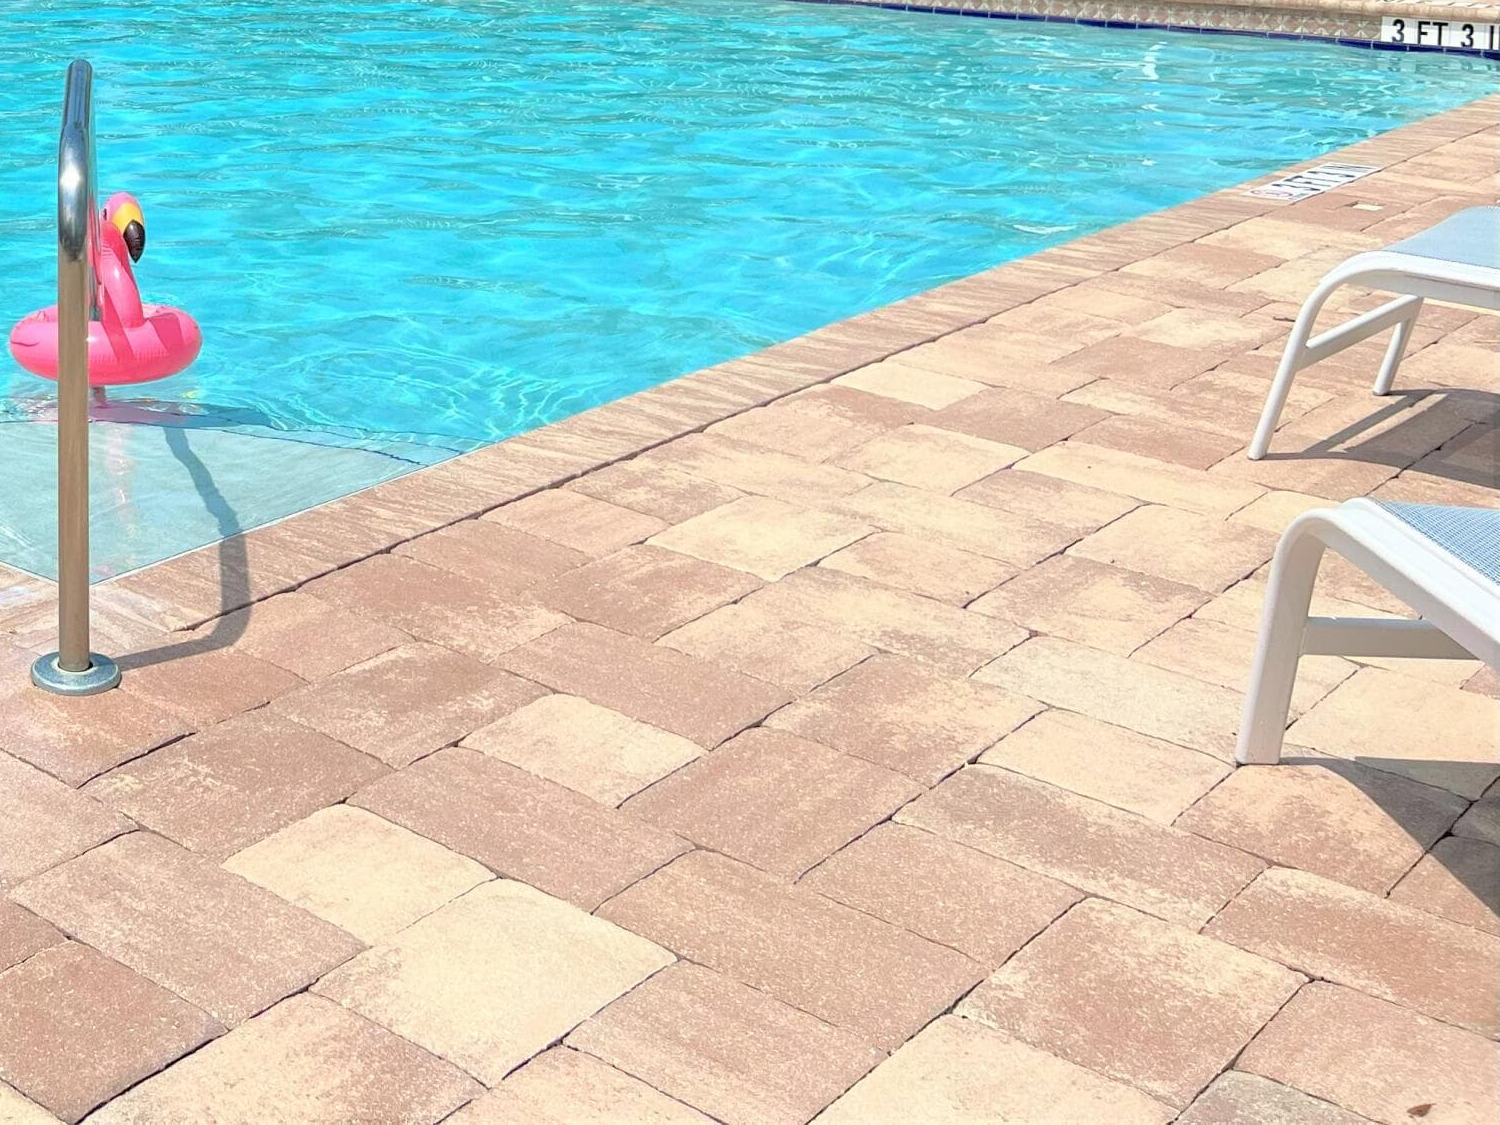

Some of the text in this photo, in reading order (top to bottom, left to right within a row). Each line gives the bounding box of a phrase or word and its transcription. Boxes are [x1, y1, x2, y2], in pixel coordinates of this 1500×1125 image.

[1392, 19, 1500, 50] 3 FT 3 I
